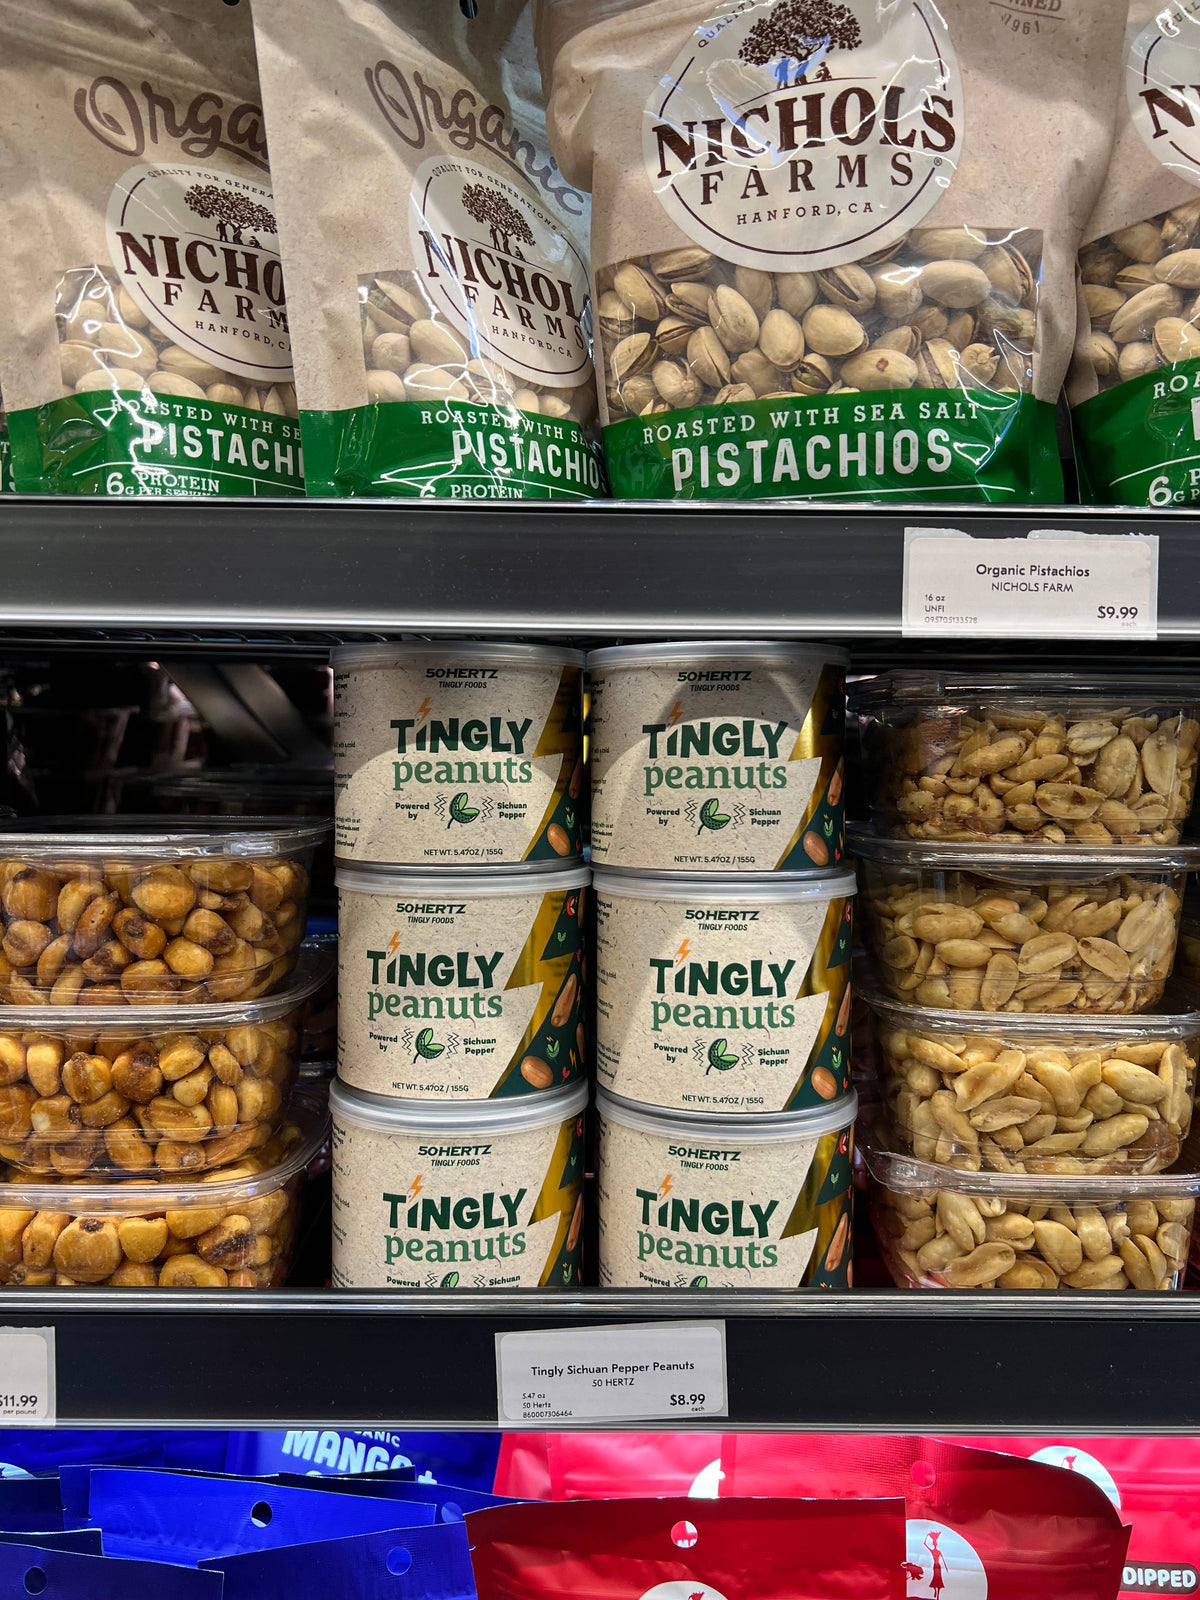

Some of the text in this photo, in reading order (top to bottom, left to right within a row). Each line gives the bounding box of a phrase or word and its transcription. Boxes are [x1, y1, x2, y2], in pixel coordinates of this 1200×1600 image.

[364, 60, 584, 216] Organic
[652, 85, 956, 178] NICHOLS
[147, 168, 191, 179] QUALITY
[197, 172, 220, 182] FOR
[700, 152, 913, 205] FARMS
[432, 164, 557, 231] QUALITY FOR GENERATIONS
[736, 202, 874, 226] HANFORD, CA
[115, 231, 287, 307] NICHO
[418, 231, 592, 324] NICHOL
[463, 284, 584, 350] FARMS
[195, 321, 274, 348] HANFORD,
[492, 325, 573, 358] HANFORD, CA
[111, 399, 213, 421] ROASTED
[223, 413, 273, 434] WITH
[643, 401, 980, 445] ROASTED WITH SEA SALT
[421, 410, 520, 430] ROASTED
[522, 421, 563, 440] WITH
[452, 430, 607, 494] PISTACHIO
[672, 428, 952, 492] PISTACHIOS
[138, 471, 219, 493] PROTEIN
[450, 484, 522, 498] PROTEIN
[976, 563, 1090, 577] Organic Pistachios
[991, 582, 1074, 593] NICHOLS FARM
[925, 594, 933, 602] 16
[925, 604, 945, 613] UNFI
[1097, 606, 1138, 620] $9.99
[426, 669, 498, 679] 50HERTZ
[678, 671, 752, 682] 50HERTZ
[390, 717, 533, 754] TINGLY
[642, 720, 788, 759] TINGLY
[392, 758, 532, 791] peanuts
[643, 762, 787, 796] peanuts
[395, 802, 429, 810] Powered
[646, 808, 680, 816] Powered
[749, 808, 781, 816] Sichuan
[408, 811, 418, 819] by
[499, 811, 526, 819] Pepper
[659, 817, 668, 826] by
[751, 818, 780, 826] Pepper
[396, 903, 467, 914] 50HERTZ
[685, 910, 760, 920] 50HERTZ
[367, 950, 504, 989] TINGLY
[650, 958, 796, 998] TINGLY
[367, 991, 502, 1021] peanuts
[651, 1001, 795, 1032] peanuts
[369, 1032, 397, 1042] Powered
[380, 1043, 387, 1052] by
[465, 1048, 494, 1056] Pepper
[654, 1042, 688, 1053] Powered
[758, 1048, 790, 1056] Sichuan
[667, 1054, 676, 1063] by
[760, 1058, 788, 1066] Pepper
[682, 1094, 696, 1102] NET
[418, 1144, 492, 1156] 50HERTZ
[668, 1145, 741, 1161] 50HERTZ
[680, 1160, 729, 1171] TINGLY FOODS
[383, 1188, 527, 1231] TINGLY
[636, 1188, 779, 1238] TINGLY
[384, 1231, 526, 1265] peanuts
[637, 1230, 778, 1269] peanuts
[387, 1276, 420, 1287] Powered
[489, 1275, 520, 1286] Sichuan
[639, 1272, 670, 1287] Powered
[531, 1361, 695, 1378] Tingly Sichuan Pepper Peanuts
[592, 1378, 635, 1387] 50 HERTZ
[669, 1394, 706, 1406] $8.99
[354, 1431, 400, 1448] ANIC
[1122, 1566, 1196, 1588] DIPPED
